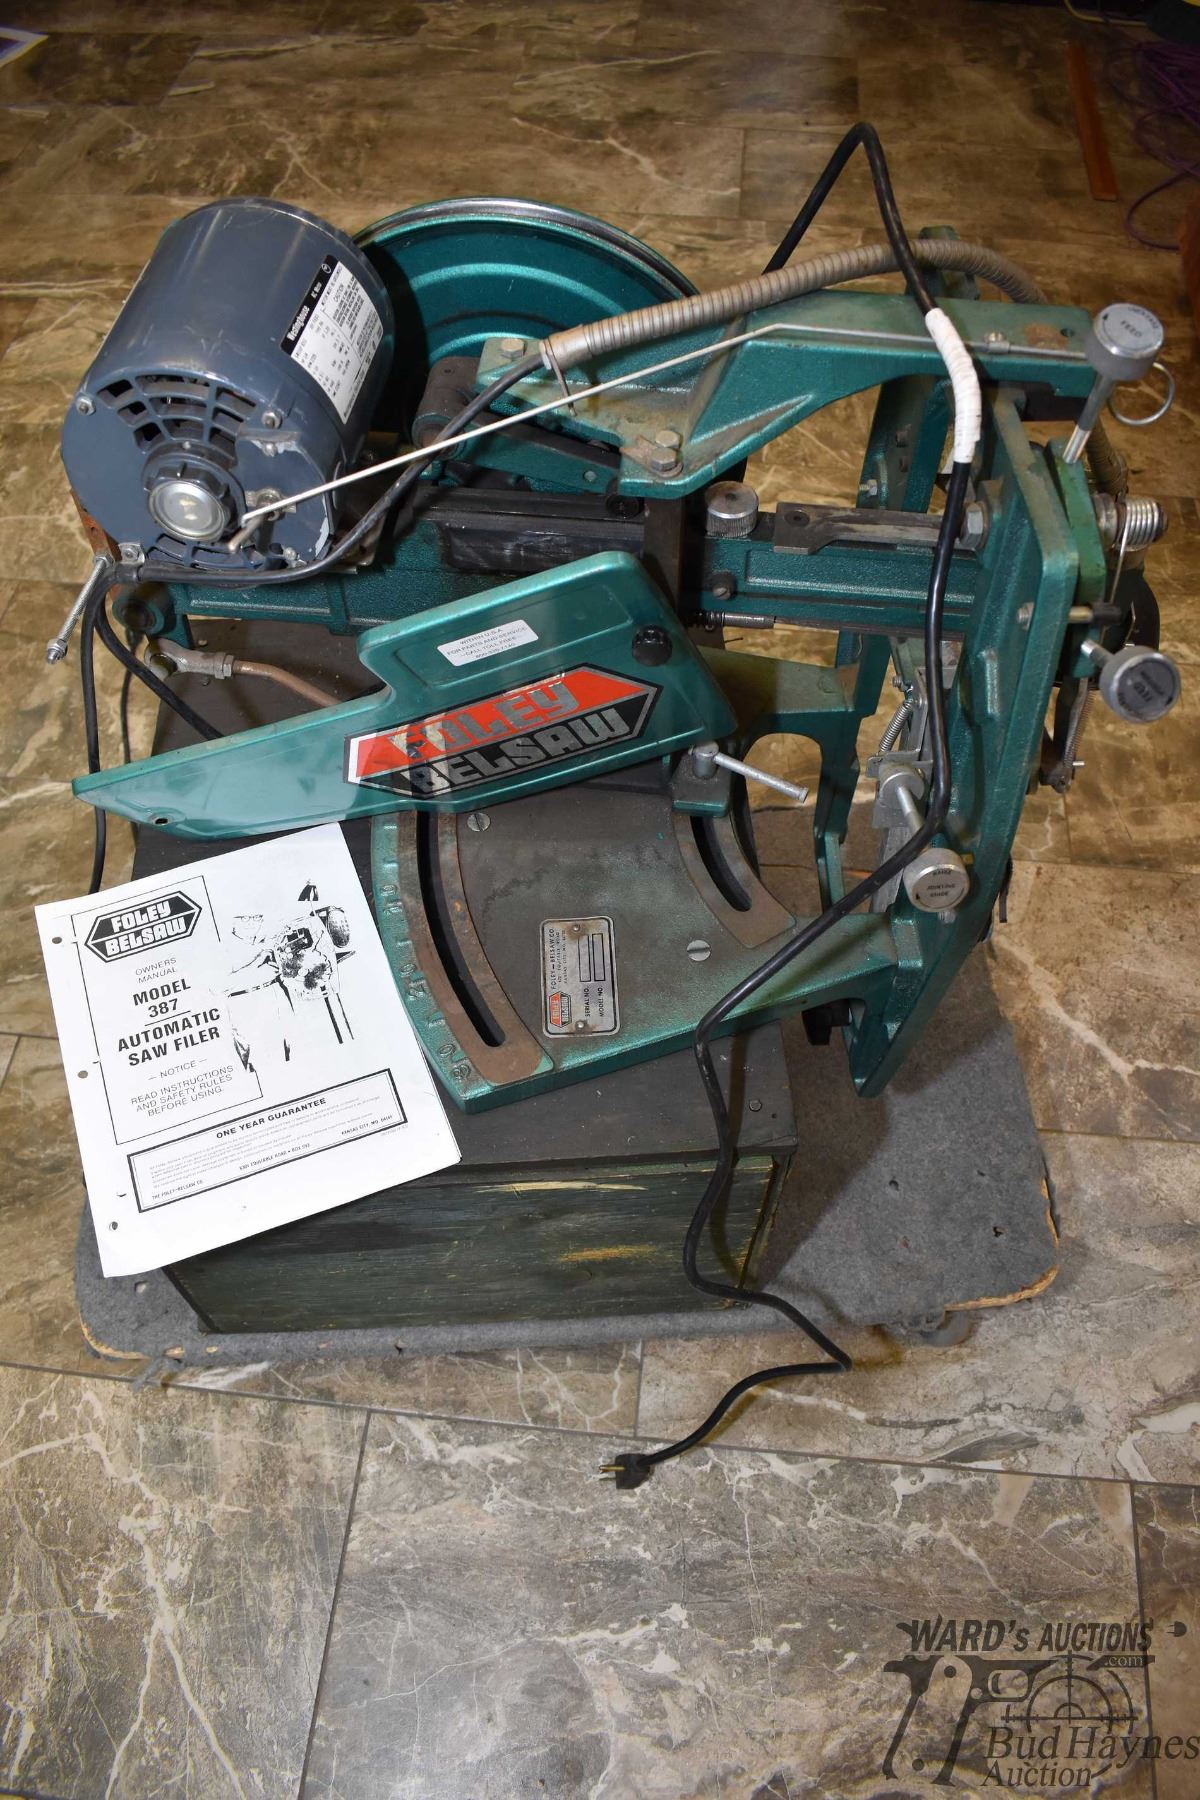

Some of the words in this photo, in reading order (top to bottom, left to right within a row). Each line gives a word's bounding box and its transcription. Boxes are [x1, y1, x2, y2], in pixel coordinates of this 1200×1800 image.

[286, 305, 310, 341] Westinghouse
[388, 681, 580, 759] FOLEY
[400, 708, 630, 793] BELSAW
[110, 900, 171, 933] FOLEY
[104, 917, 187, 956] BELSAW
[135, 957, 177, 976] OWNERS
[138, 967, 177, 984] MANUAL
[132, 978, 191, 1006] MODEL
[148, 998, 178, 1018] 387
[118, 1008, 221, 1052] AUTOMATIC
[128, 1043, 168, 1067] SAW
[174, 1026, 220, 1052] FILER
[131, 1091, 158, 1105] READ
[160, 1065, 234, 1095] INSTRUCTIONS
[160, 1060, 197, 1078] NOTICE
[136, 1101, 157, 1112] AND
[160, 1087, 196, 1104] SAFETY
[200, 1074, 233, 1090] RULES
[148, 1098, 188, 1117] BEFORE
[216, 1127, 237, 1139] ONE
[239, 1118, 265, 1131] YEAR
[267, 1097, 326, 1121] GUARANTEE
